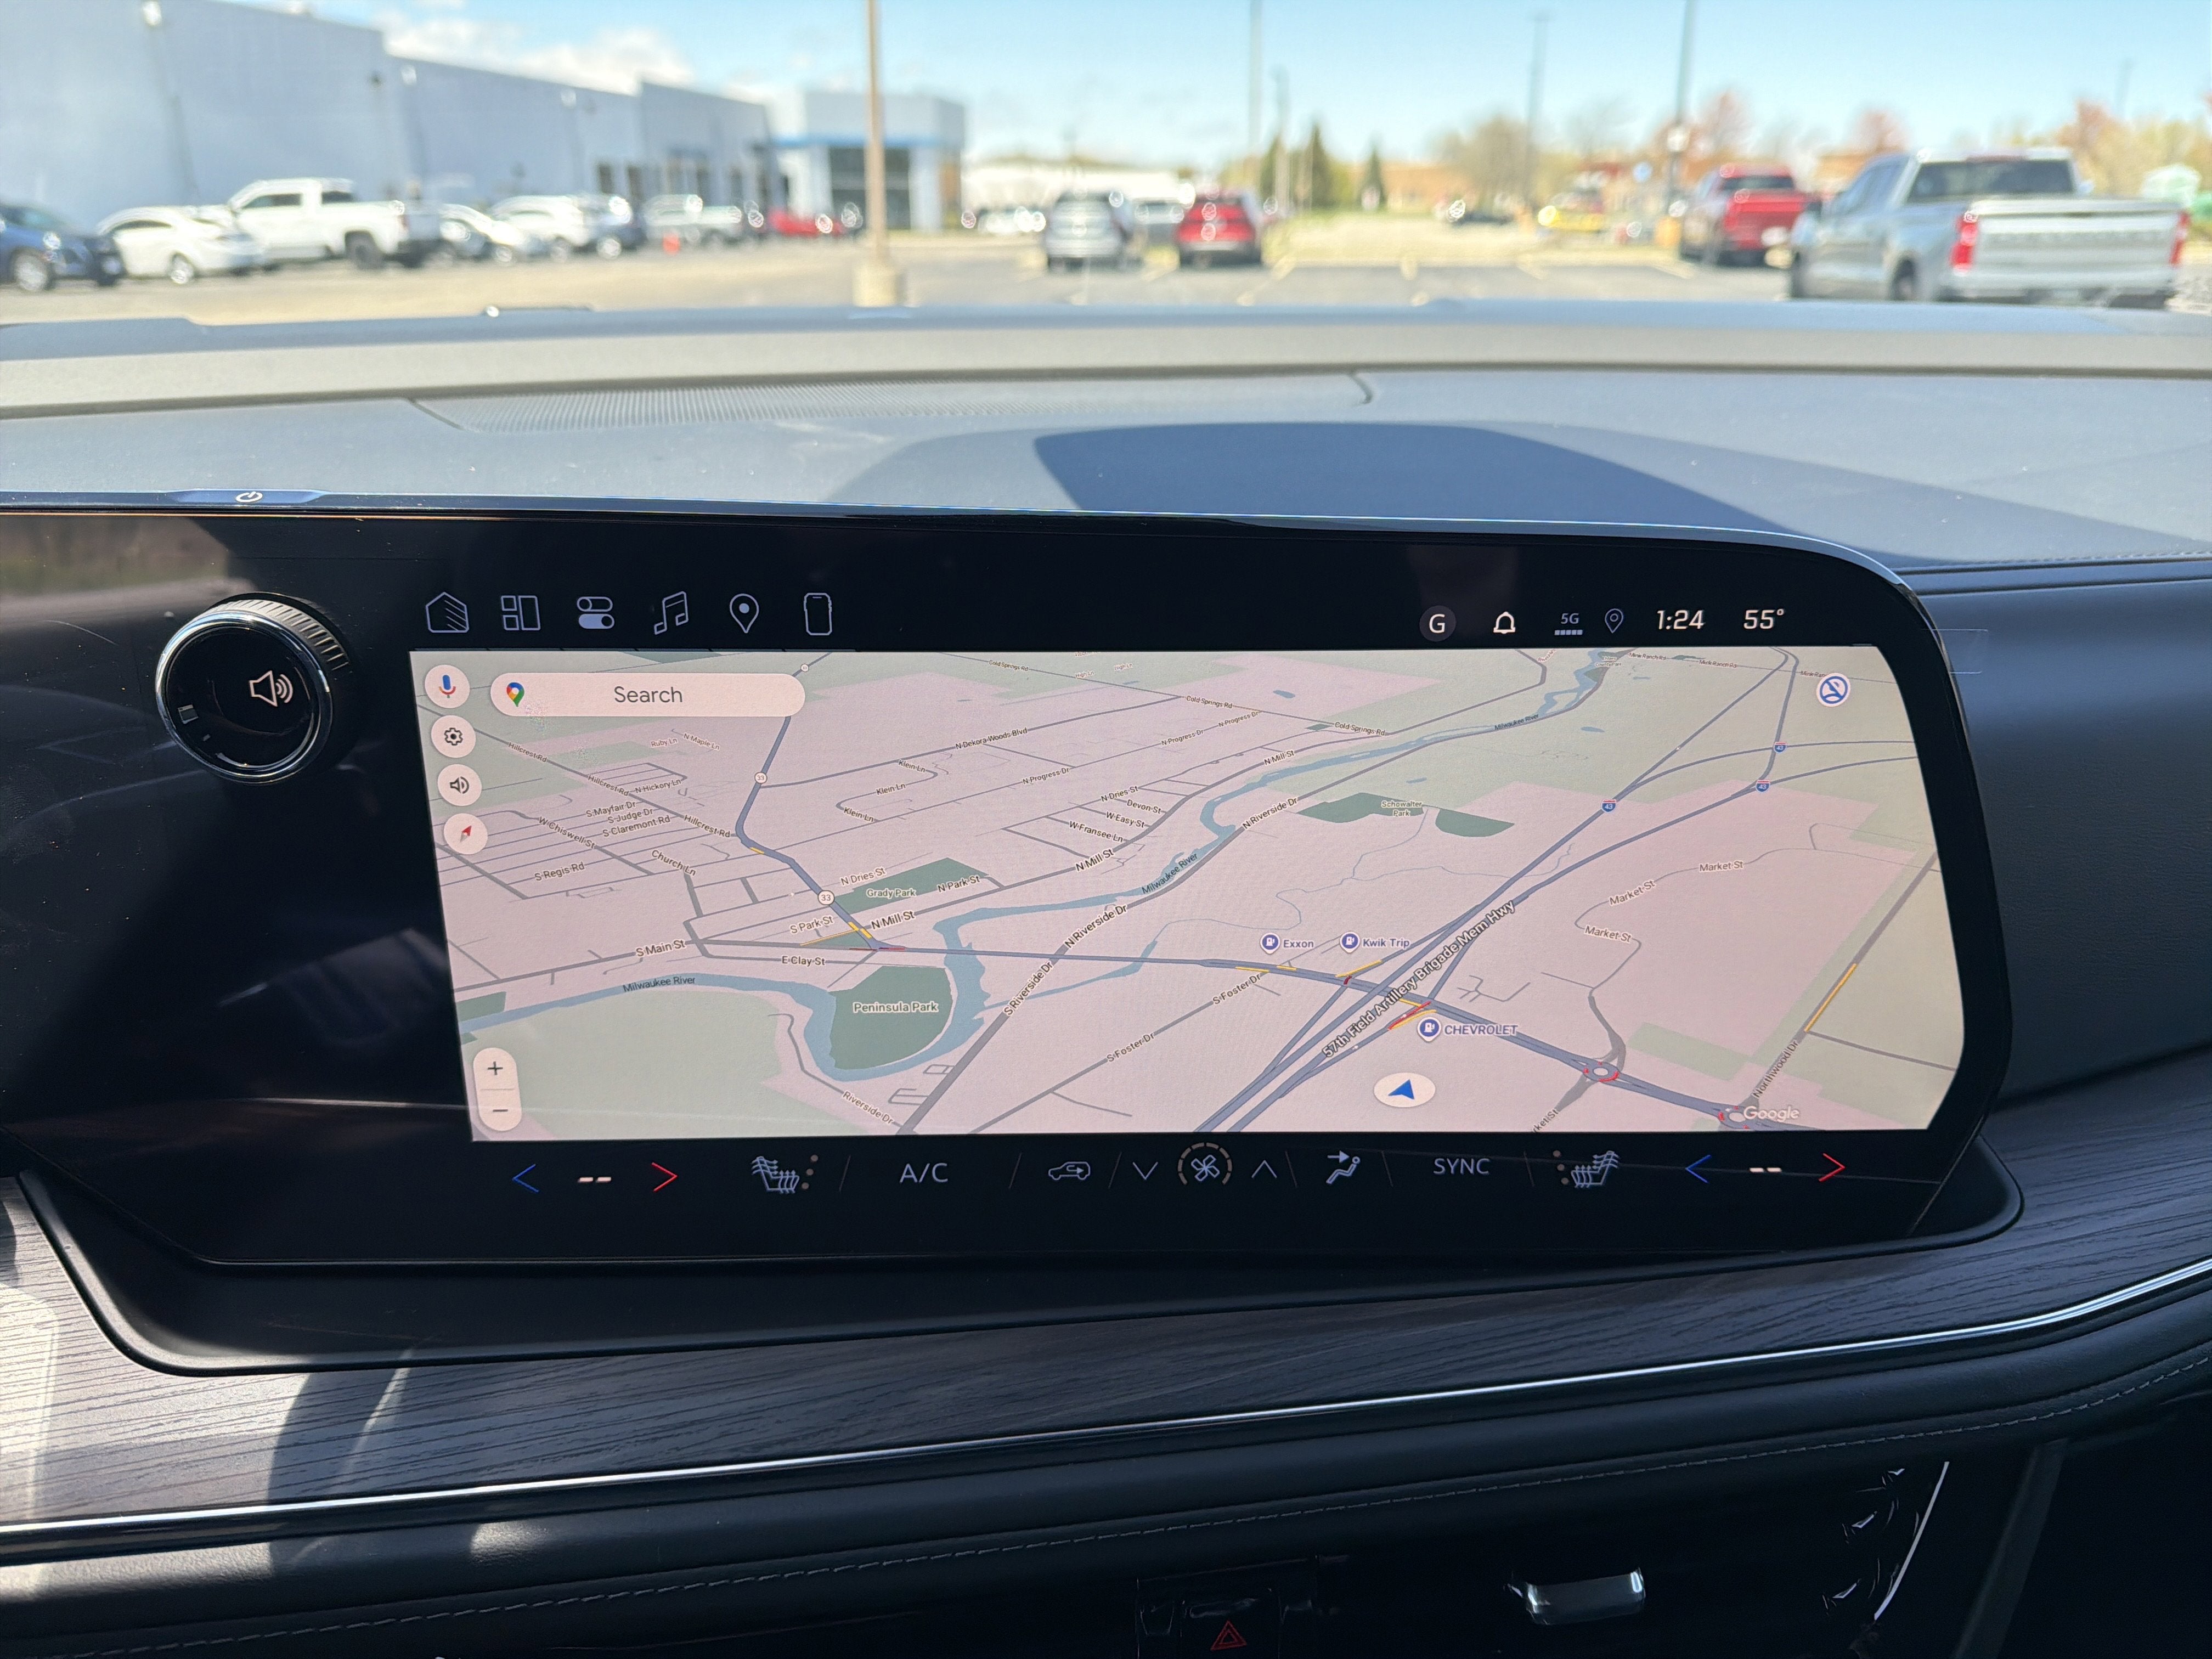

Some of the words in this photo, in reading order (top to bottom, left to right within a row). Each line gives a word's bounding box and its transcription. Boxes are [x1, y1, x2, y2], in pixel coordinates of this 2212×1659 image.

[1429, 614, 1446, 634] G
[1561, 613, 1579, 624] 5G
[1657, 610, 1705, 630] 1:24
[1744, 608, 1784, 629] 55°
[614, 686, 682, 703] Search
[1186, 695, 1200, 703] Cold
[1201, 698, 1222, 708] Springs
[1224, 714, 1250, 726] Progress
[1494, 718, 1523, 730] Milwaukee
[1525, 714, 1539, 723] River
[962, 736, 987, 748] Dekora
[988, 731, 1011, 742] Woods
[1012, 727, 1027, 736] Blvd
[1168, 732, 1195, 744] Progress
[1350, 724, 1374, 735] Springs
[651, 739, 668, 747] Ruby
[691, 736, 710, 747] Maple
[508, 742, 536, 758] Hillcrest
[538, 754, 548, 763] Rd
[1272, 752, 1285, 763] Mill
[899, 760, 916, 770] Klein
[1029, 770, 1059, 783] Progress
[588, 775, 618, 792] Hillcrest
[619, 788, 629, 796] Rd
[642, 782, 670, 792] Hickory
[876, 786, 895, 795] Klein
[1109, 789, 1128, 800] Dries
[594, 805, 624, 816] Mayfair
[844, 807, 862, 818] Klein
[1127, 800, 1149, 811] Devon
[1250, 802, 1287, 825] Riverside
[1289, 798, 1297, 806] Dr
[611, 819, 657, 835] Claremont
[658, 815, 670, 823] Rd
[617, 811, 642, 822] Judge
[1116, 814, 1136, 827] Easy
[539, 817, 549, 825] W
[549, 821, 584, 844] Chiswell
[585, 839, 595, 849] St
[684, 815, 717, 834] Hillcrest
[719, 829, 730, 838] Rd
[1079, 825, 1110, 838] Fransee
[1113, 834, 1123, 843] Ln
[652, 850, 683, 870] Church
[684, 866, 696, 876] Ln
[1076, 863, 1084, 872] N
[1086, 855, 1102, 868] Mill
[1103, 849, 1114, 859] St
[1699, 862, 1730, 872] Market
[1734, 861, 1743, 869] St
[535, 873, 541, 881] S
[543, 867, 569, 879] Regis
[571, 862, 584, 871] Rd
[841, 877, 848, 885] N
[850, 871, 874, 883] Dries
[876, 868, 886, 876] St
[1142, 866, 1179, 894] Milwaukee
[1179, 853, 1198, 869] River
[867, 889, 893, 899] Grady
[938, 884, 945, 893] N
[948, 878, 967, 890] Park
[1610, 887, 1643, 905] Market
[1644, 880, 1655, 890] St
[791, 925, 798, 934] S
[800, 919, 820, 931] Park
[822, 916, 833, 924] St
[871, 921, 879, 929] N
[882, 914, 901, 926] Mill
[903, 911, 915, 919] St
[1065, 938, 1074, 948] N
[1073, 911, 1114, 941] Riverside
[1115, 905, 1127, 915] Dr
[1585, 926, 1618, 940] Market
[1621, 933, 1631, 942] St
[636, 948, 644, 957] S
[645, 943, 672, 954] Main
[674, 940, 685, 949] St
[1283, 940, 1313, 948] Exxon
[1363, 939, 1385, 947] Kwik
[1390, 939, 1409, 949] Trip
[791, 957, 812, 966] Clay
[815, 957, 825, 966] St
[623, 978, 670, 992] Milwaukee
[673, 977, 695, 985] River
[1322, 1036, 1348, 1057] 57th
[1346, 1011, 1375, 1039] Field
[1374, 976, 1417, 1015] Artillery
[1414, 944, 1459, 981] Brigade
[1456, 921, 1487, 946] Mem
[1486, 900, 1515, 923] Hwy
[1004, 1006, 1013, 1016] S
[1011, 971, 1043, 1009] Riverside
[1041, 961, 1053, 975] Dr
[1213, 996, 1220, 1005] S
[1220, 979, 1249, 1001] Foster
[1250, 973, 1261, 984] Dr
[854, 1003, 909, 1012] Peninsula
[912, 1003, 938, 1011] Park
[1444, 1025, 1518, 1035] CHEVROLET
[1115, 1040, 1143, 1058] Foster
[1143, 1032, 1154, 1042] Dr
[1754, 1052, 1790, 1097] Northwood
[1789, 1041, 1798, 1053] Dr
[843, 1091, 882, 1119] Riverside
[883, 1114, 893, 1124] Dr
[1743, 1105, 1799, 1121] Google
[1532, 1118, 1549, 1132] rket
[1547, 1109, 1559, 1119] St
[900, 1163, 948, 1183] A/C
[1434, 1158, 1491, 1175] SYNC
